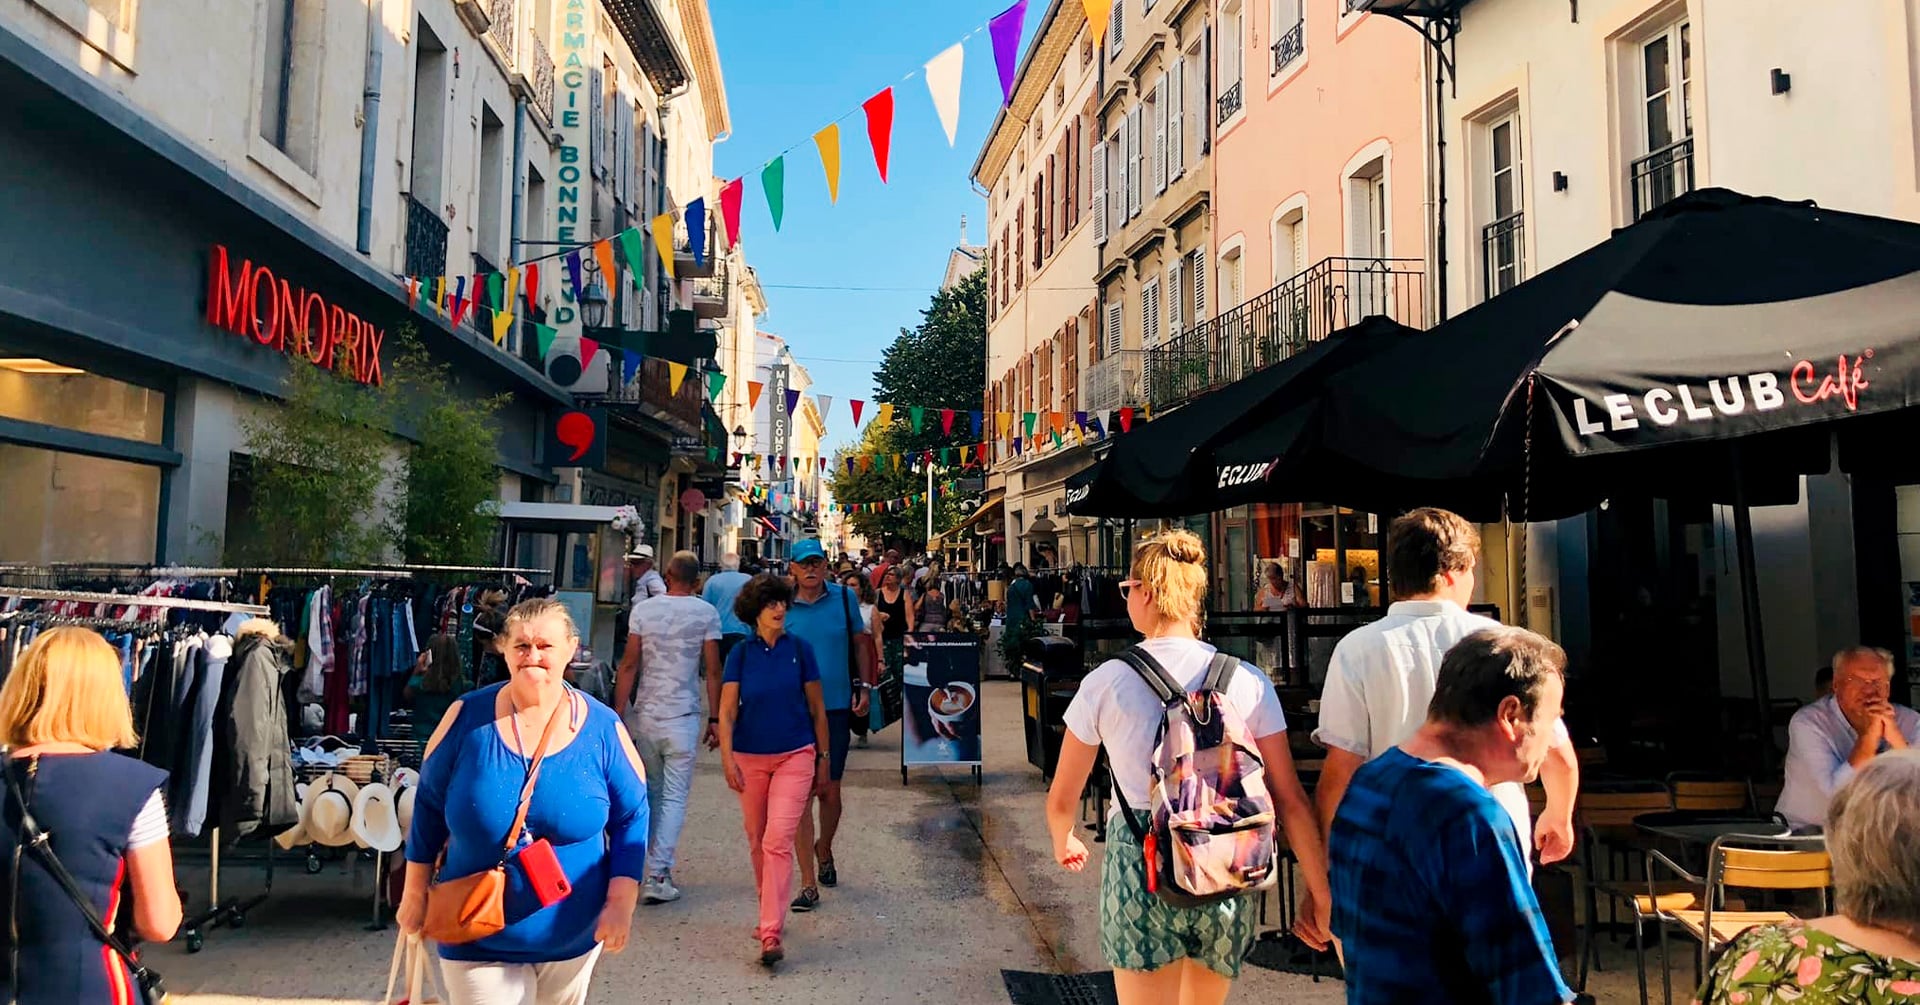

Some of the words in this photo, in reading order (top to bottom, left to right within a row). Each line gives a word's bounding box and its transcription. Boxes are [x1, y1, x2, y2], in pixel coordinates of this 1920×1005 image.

[207, 244, 385, 388] MONOPRIX
[775, 370, 785, 412] MAGIC
[1573, 393, 1639, 435] LE
[1643, 372, 1785, 426] CLUB
[1790, 354, 1869, 411] Café
